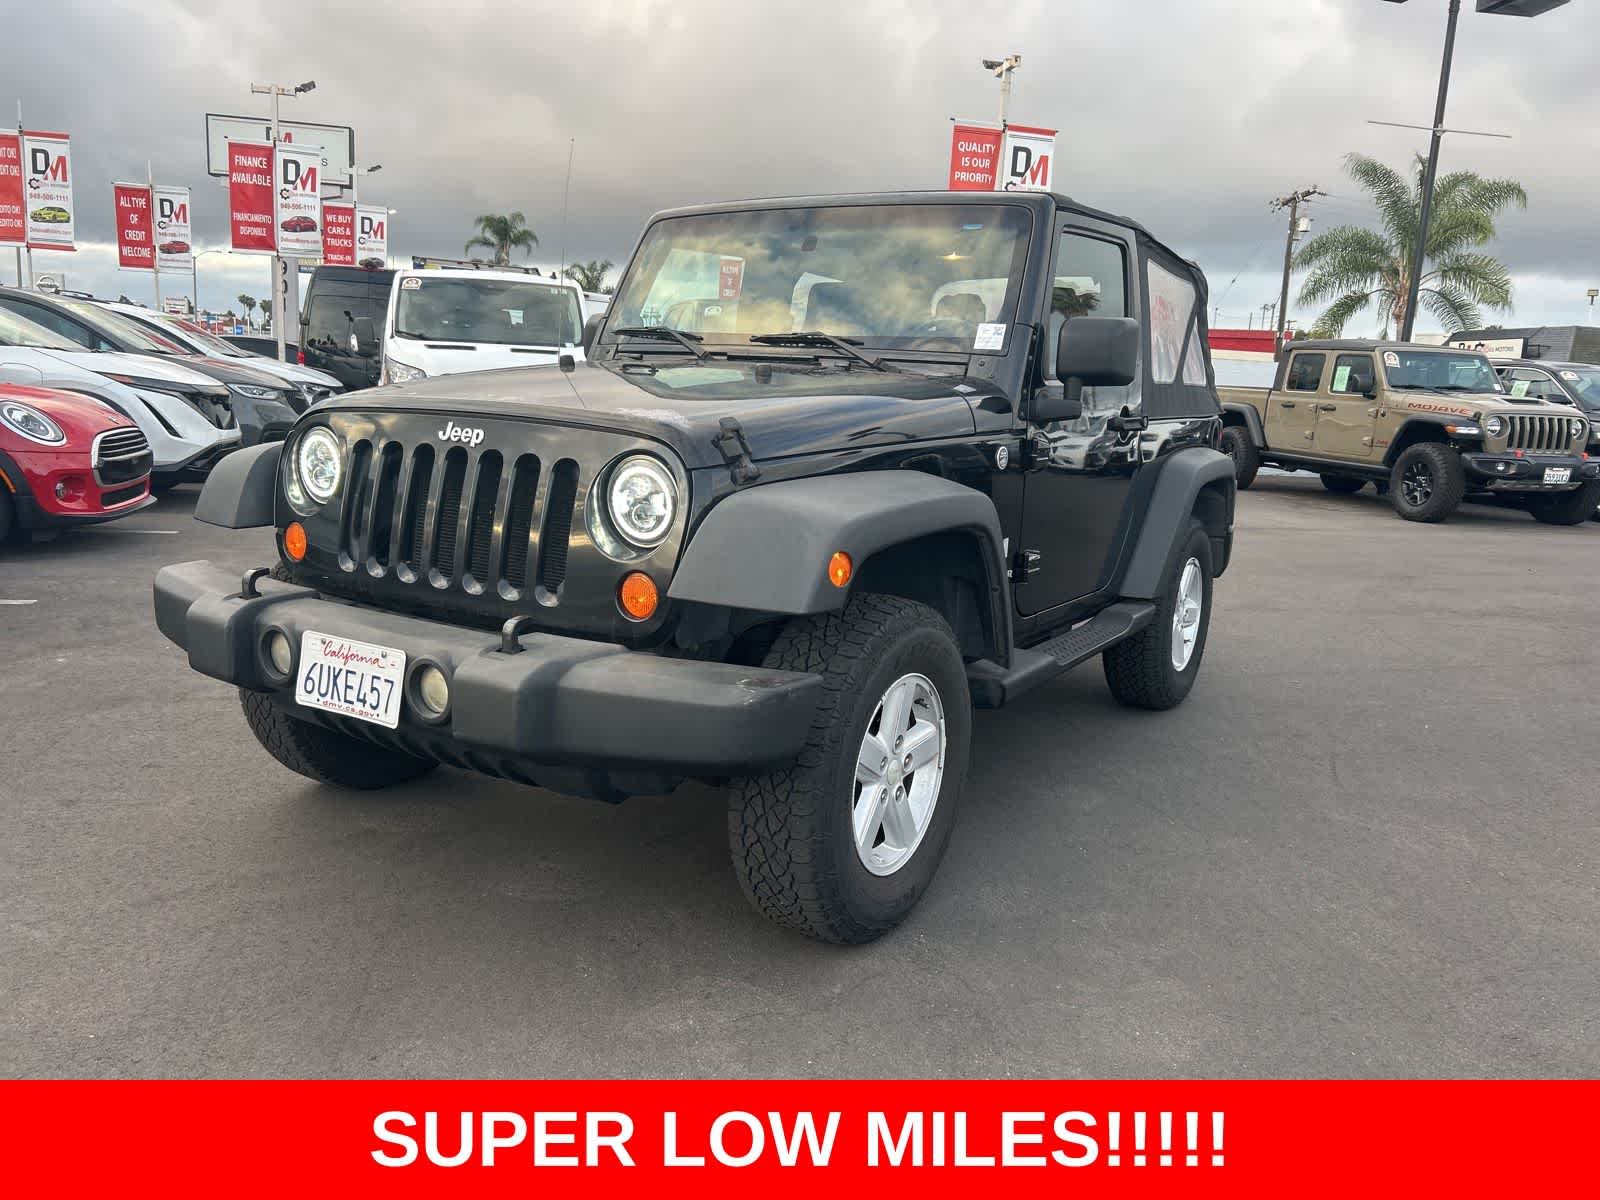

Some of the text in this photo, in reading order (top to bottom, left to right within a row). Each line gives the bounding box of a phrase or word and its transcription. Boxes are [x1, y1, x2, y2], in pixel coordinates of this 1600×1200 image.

[958, 141, 996, 154] QUALITY
[234, 155, 267, 169] FINANCE
[961, 157, 991, 169] IS OUR
[231, 172, 272, 187] AVAILABLE
[954, 171, 993, 185] PRIORITY
[120, 196, 147, 209] ALL TYPE
[129, 213, 139, 225] OF
[326, 214, 352, 224] WE BUY
[124, 229, 146, 241] CREDIT
[327, 226, 351, 236] CARS &
[326, 238, 353, 248] TRUCKS
[121, 245, 152, 258] WELCOME
[327, 253, 352, 263] TRADE-IN
[1407, 402, 1473, 416] MOJAVE
[438, 420, 485, 448] Jeep
[323, 639, 386, 669] California
[303, 661, 394, 715] 6UKE457
